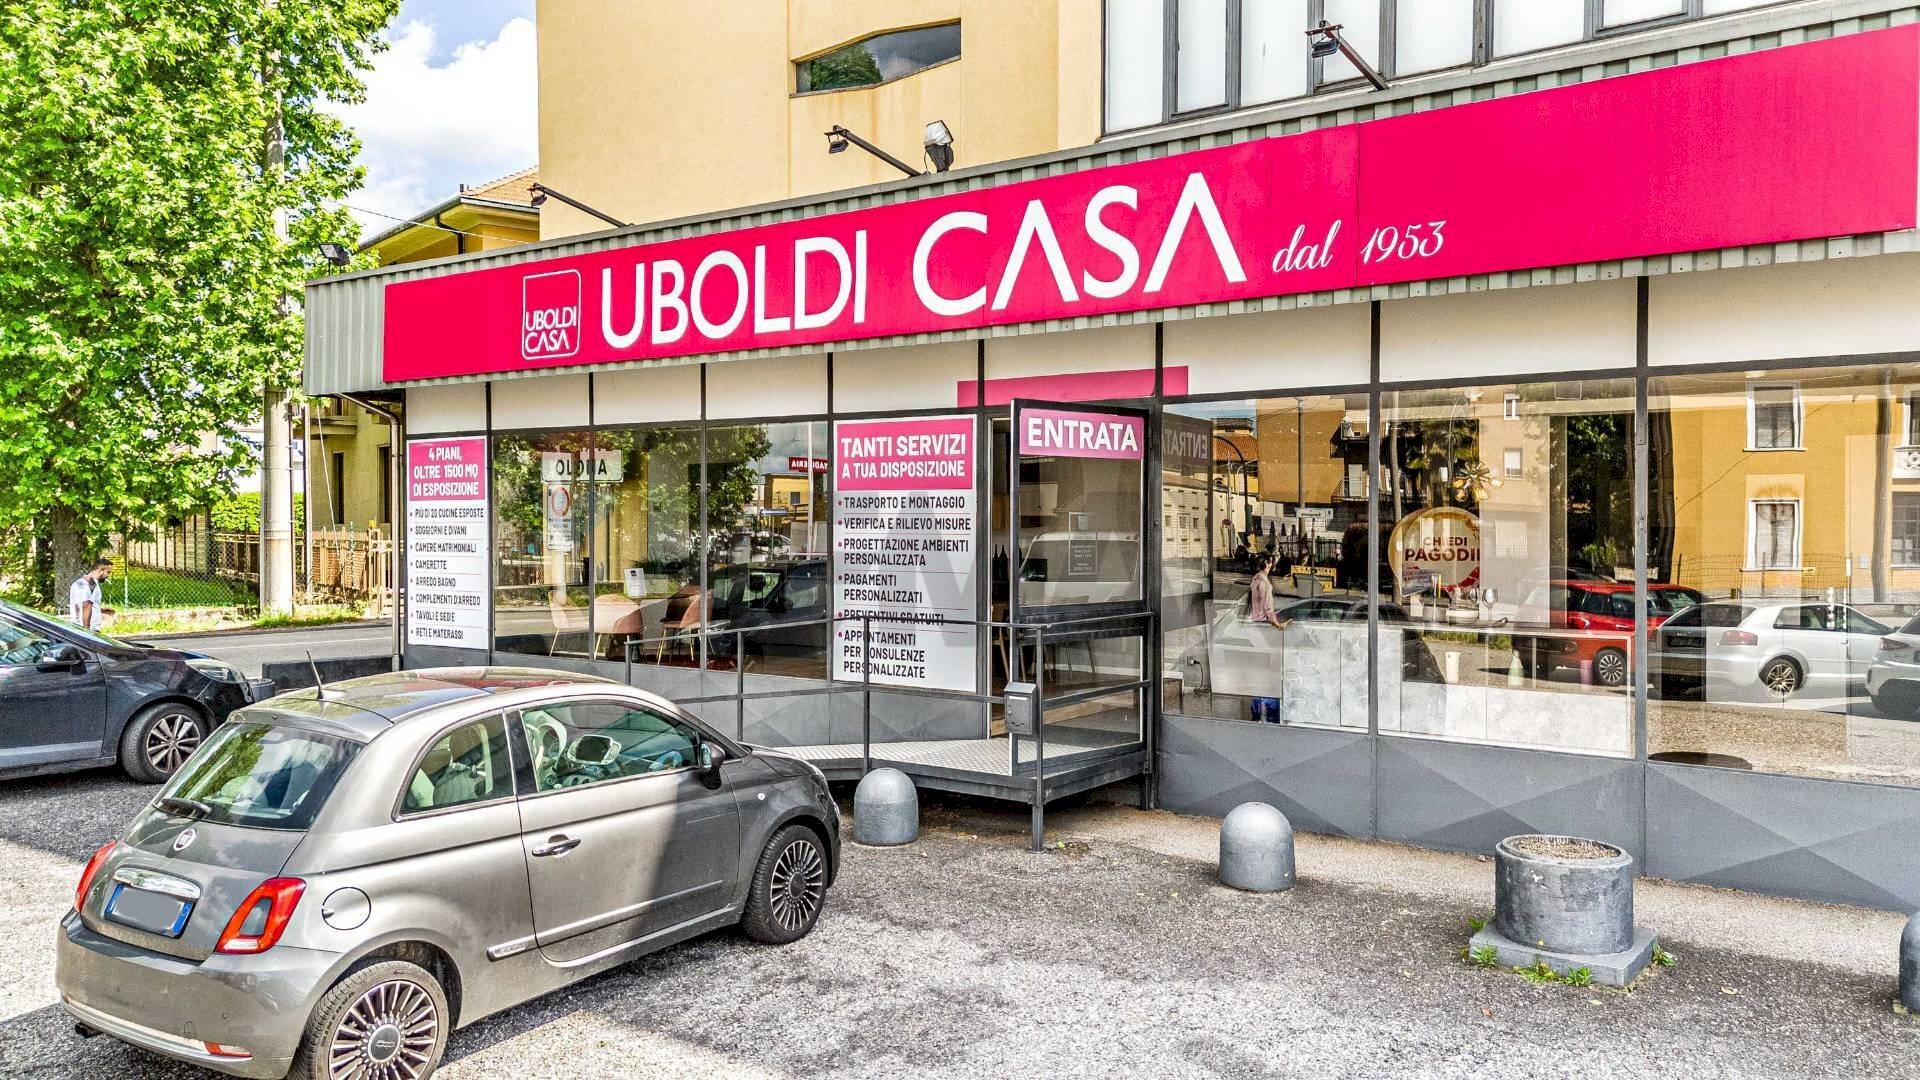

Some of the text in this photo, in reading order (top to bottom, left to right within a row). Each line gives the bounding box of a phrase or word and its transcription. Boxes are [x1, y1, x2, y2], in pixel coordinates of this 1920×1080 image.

[601, 172, 1447, 349] UBOLDI CASA dal 1953
[525, 305, 577, 332] UBOLDI
[525, 328, 570, 353] CASA
[1027, 417, 1139, 452] ENTRATA
[840, 434, 966, 458] TANTI SERVIZI
[428, 446, 462, 462] 4 PIANI,
[413, 463, 479, 480] OLTRE 1500 MQ
[556, 458, 608, 476] OLOA
[842, 459, 966, 479] A TUA DISPOSIZIONE
[413, 481, 480, 497] DI ESPOSIZIONE
[844, 496, 966, 509] TRASPORTO E MONTAGGIO
[431, 508, 438, 518] 20
[438, 508, 458, 518] CUCINE
[459, 508, 484, 518] ESPOSTE
[415, 525, 444, 535] SOGGIORNI
[449, 526, 467, 536] DIVANI
[844, 517, 971, 531] VERIFICA E RILIEVO MISURE
[415, 542, 477, 553] CAMERE MATRIMONIALI
[844, 538, 969, 552] PROGETTAZIONE AMBIENTI
[1423, 536, 1468, 547] CHEDI
[415, 559, 447, 570] CAMERETTE
[844, 553, 926, 566] PERSONALIZZATA
[415, 576, 456, 588] ARREDO BAGNO
[844, 573, 897, 586] PAGAMENTI
[415, 593, 481, 606] COMPLEMENTI D'ARREDO
[844, 588, 923, 604] PERSONALIZZATI
[415, 610, 435, 621] TAVOLI
[439, 612, 456, 622] SEDIE
[844, 609, 944, 627] PREVENTIVI GRATUITI
[415, 627, 428, 638] RETI
[432, 628, 464, 640] MATERASSI
[844, 629, 916, 646] APPNTAMENTI
[844, 645, 926, 662] PER ONSULENZE
